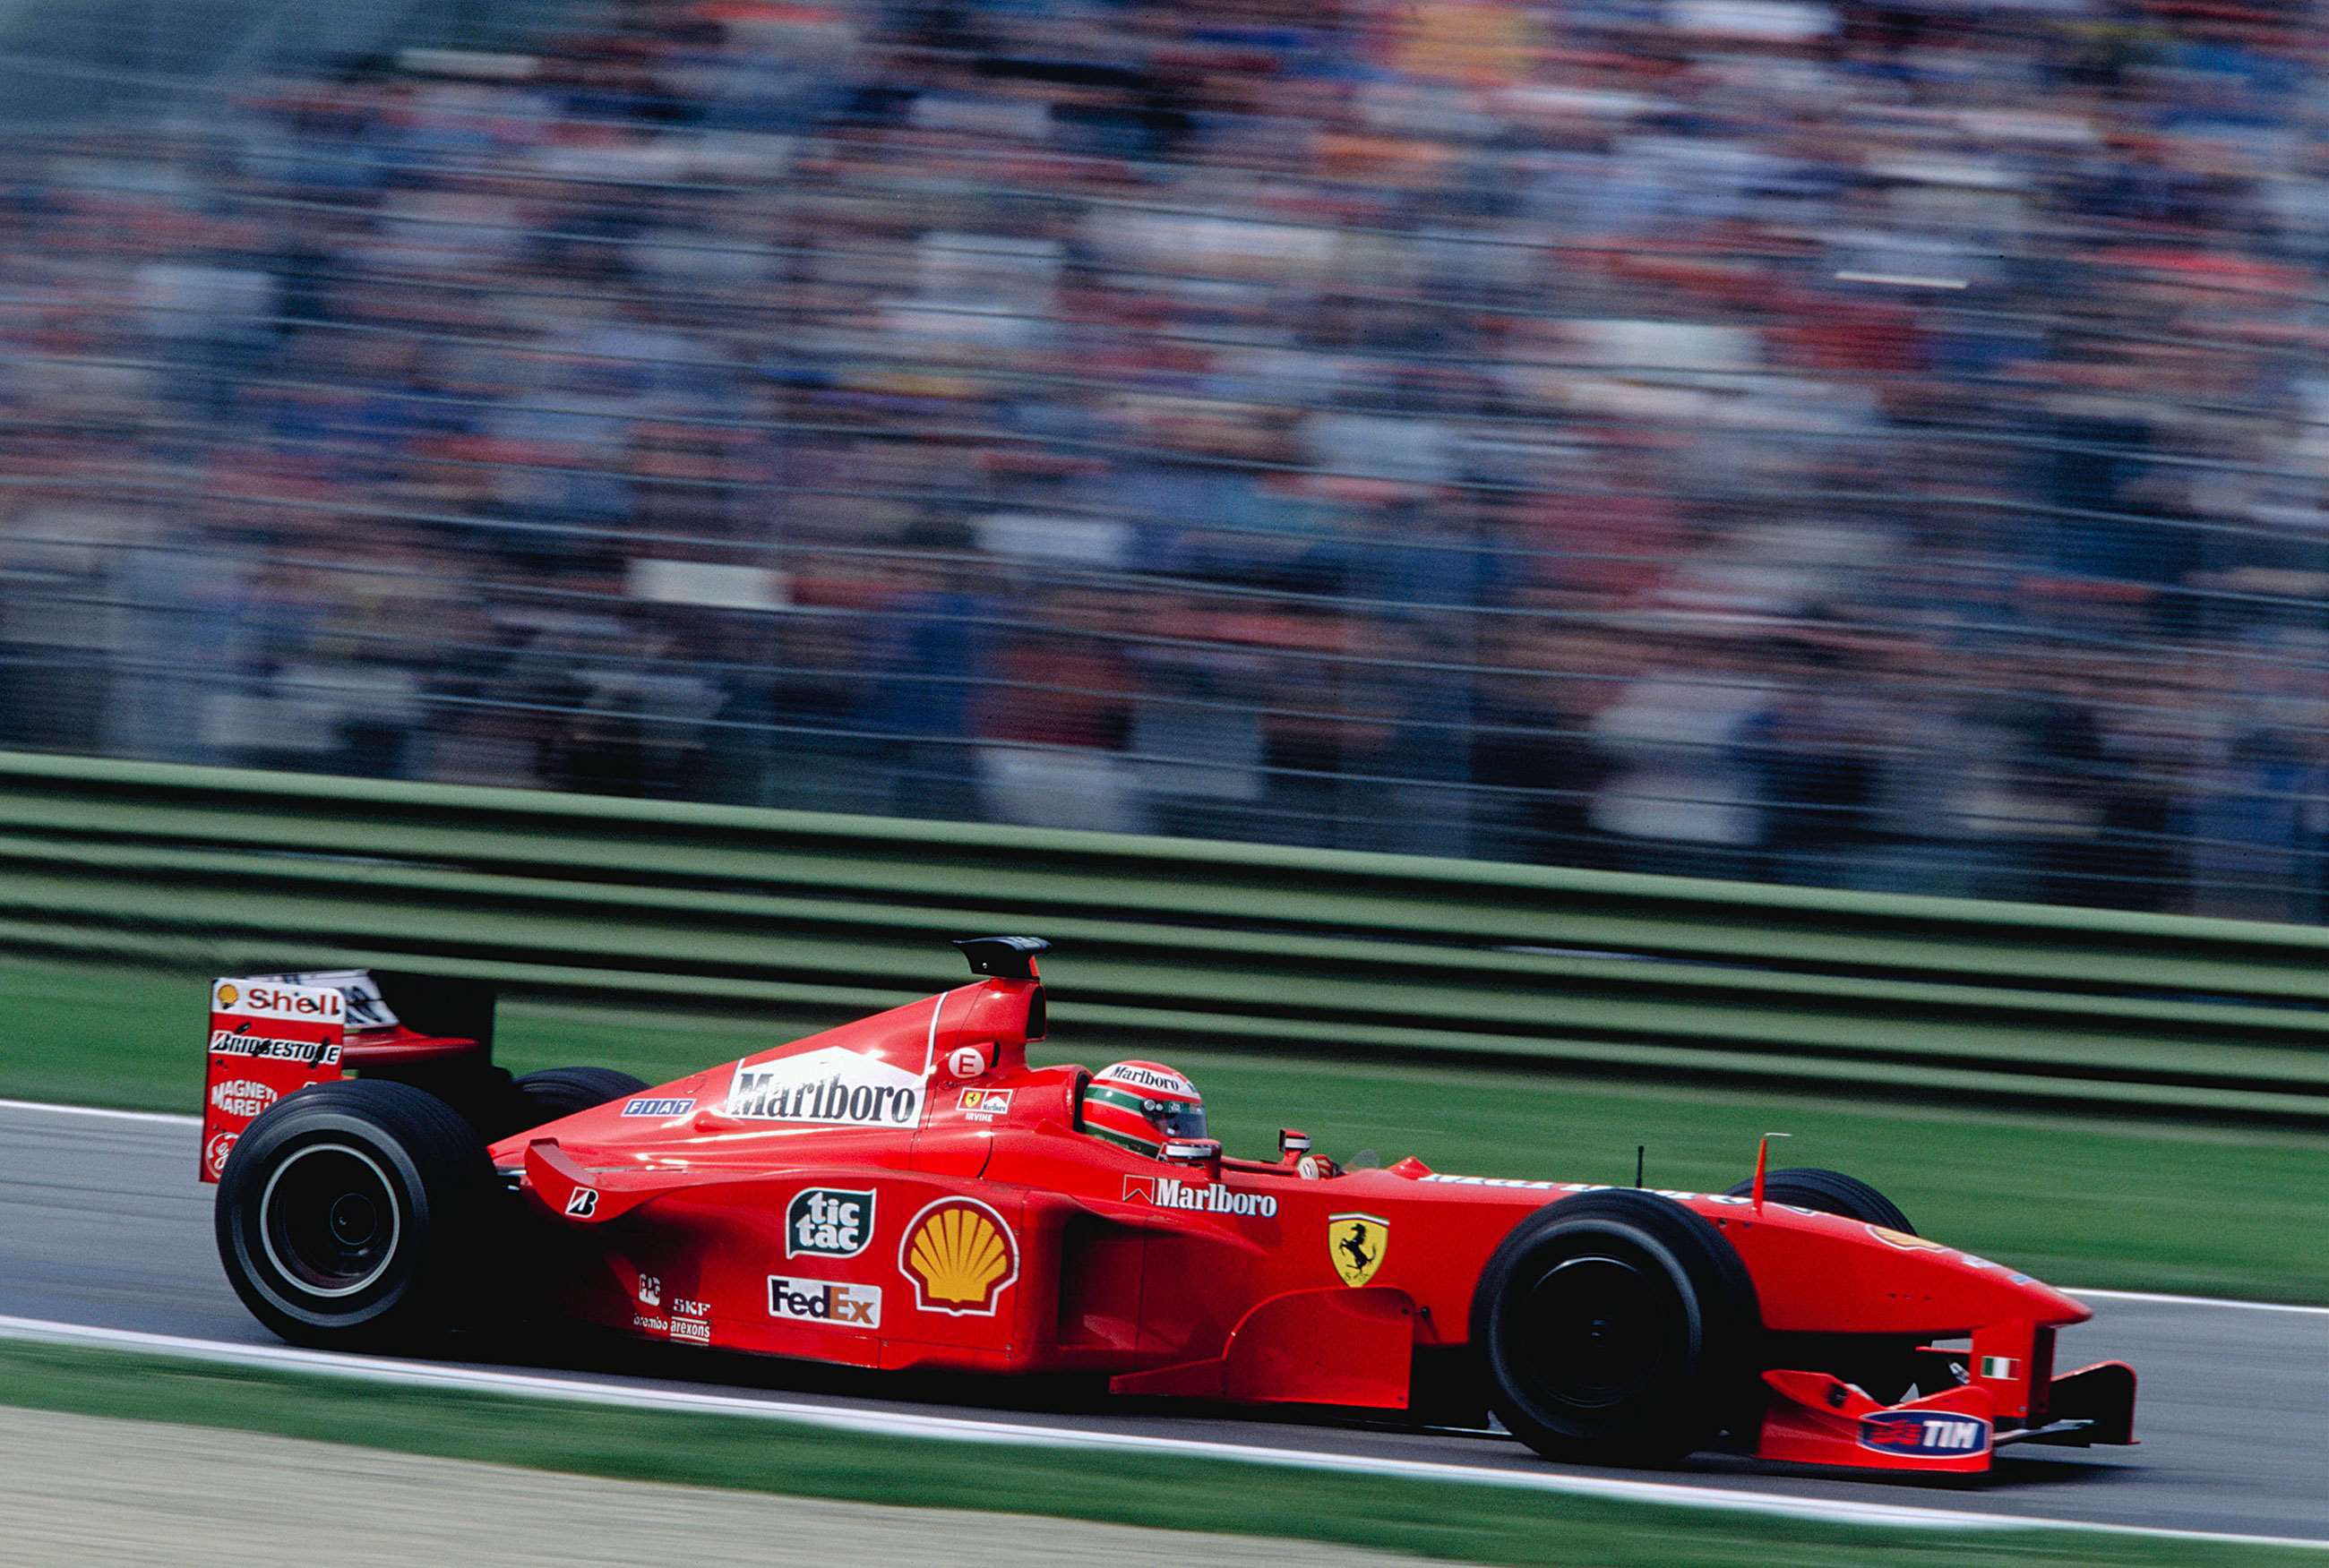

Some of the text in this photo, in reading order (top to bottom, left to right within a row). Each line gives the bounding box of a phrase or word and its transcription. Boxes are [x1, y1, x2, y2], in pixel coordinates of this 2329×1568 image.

[248, 988, 339, 1015] Shell
[211, 1031, 341, 1064] BRIDESTOE
[958, 1053, 975, 1075] E
[1110, 1067, 1180, 1091] Marlboro
[211, 1092, 270, 1117] MAREL
[626, 1100, 694, 1115] FIAT
[731, 1072, 915, 1124] Marlboro
[965, 1112, 993, 1123] IRVINE
[807, 1191, 860, 1228] tic
[1156, 1178, 1277, 1217] Marlboro
[795, 1213, 859, 1250] tac
[674, 1298, 711, 1316] SKF
[771, 1278, 874, 1324] FedEx
[633, 1312, 668, 1331] brembo
[670, 1320, 710, 1338] arexons
[1922, 1419, 1979, 1449] TIM
